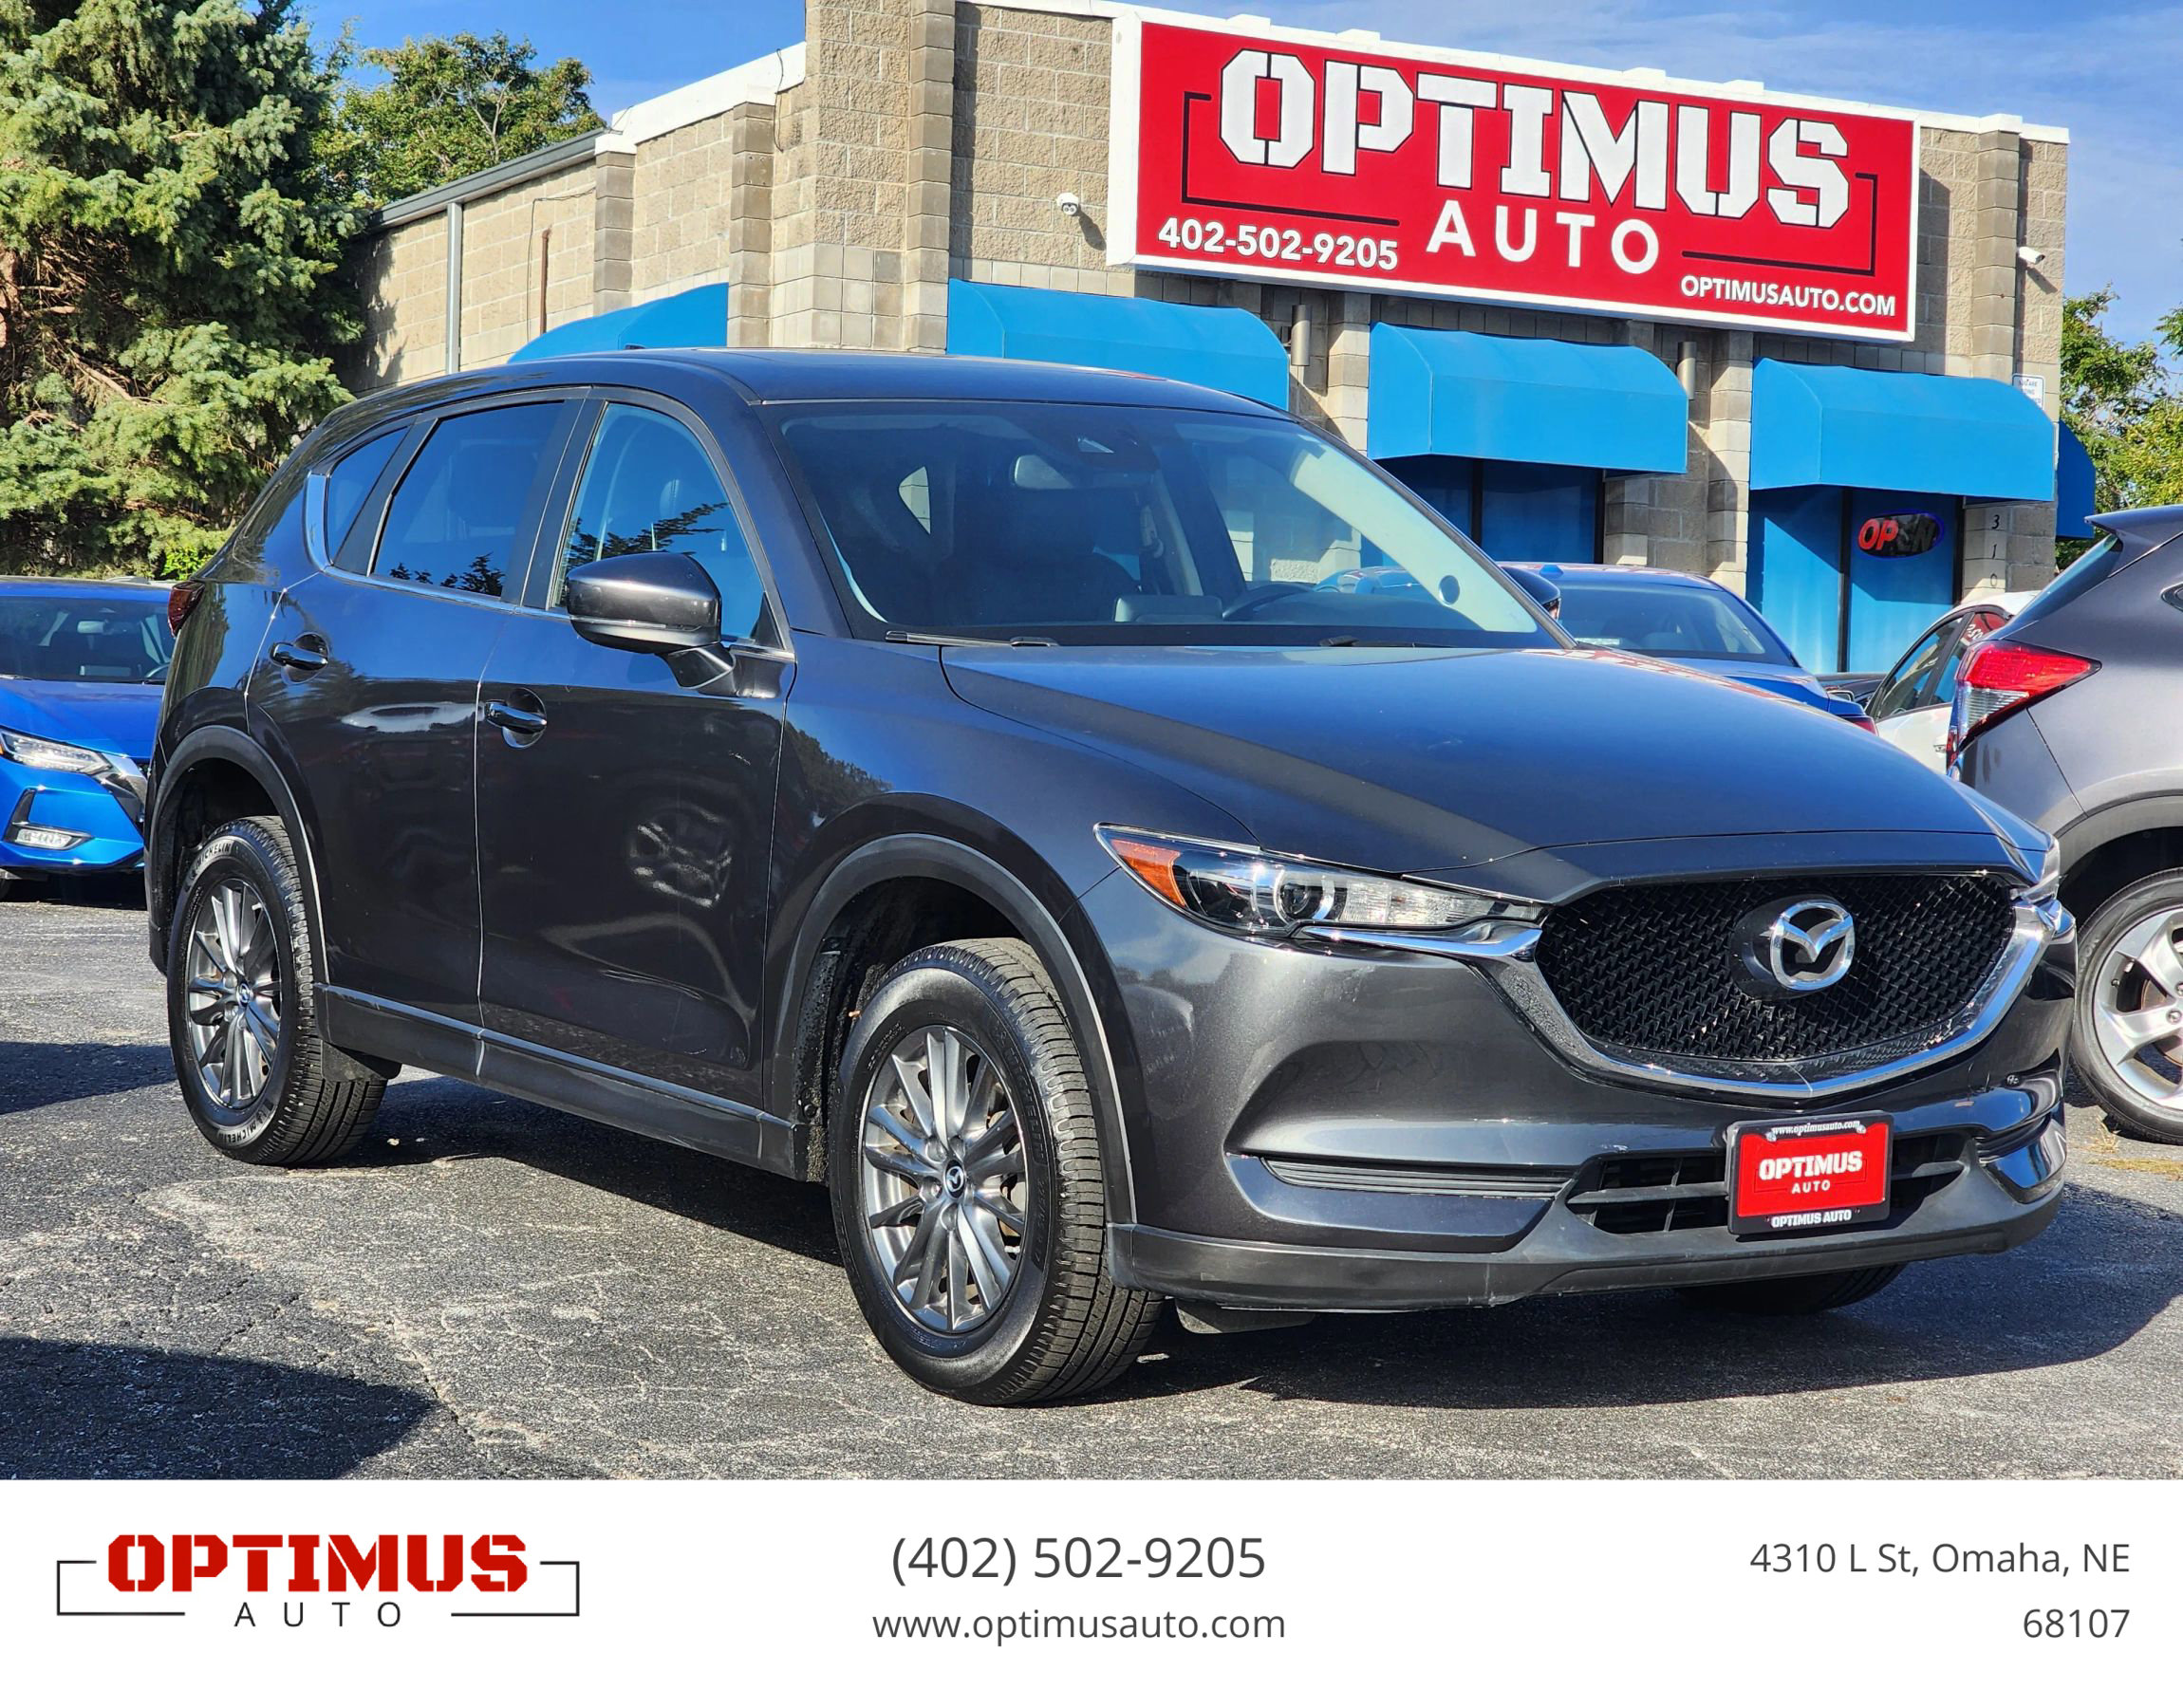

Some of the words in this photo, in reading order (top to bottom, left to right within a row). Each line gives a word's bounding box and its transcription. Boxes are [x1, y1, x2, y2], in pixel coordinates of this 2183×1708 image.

[1221, 49, 1851, 229] OPTIMUS
[1158, 216, 1399, 270] 402-502-9205
[1426, 199, 1660, 274] AUTO
[1680, 274, 1896, 318] OPTIMUSAUTO.COM
[195, 843, 233, 871] MICHELIN
[1771, 1120, 1861, 1136] www.optimusauto.com
[1759, 1150, 1863, 1181] OPTIMUS
[1791, 1179, 1831, 1195] AUTO
[1771, 1212, 1822, 1229] OPTIMUS
[1822, 1208, 1853, 1224] AUTO
